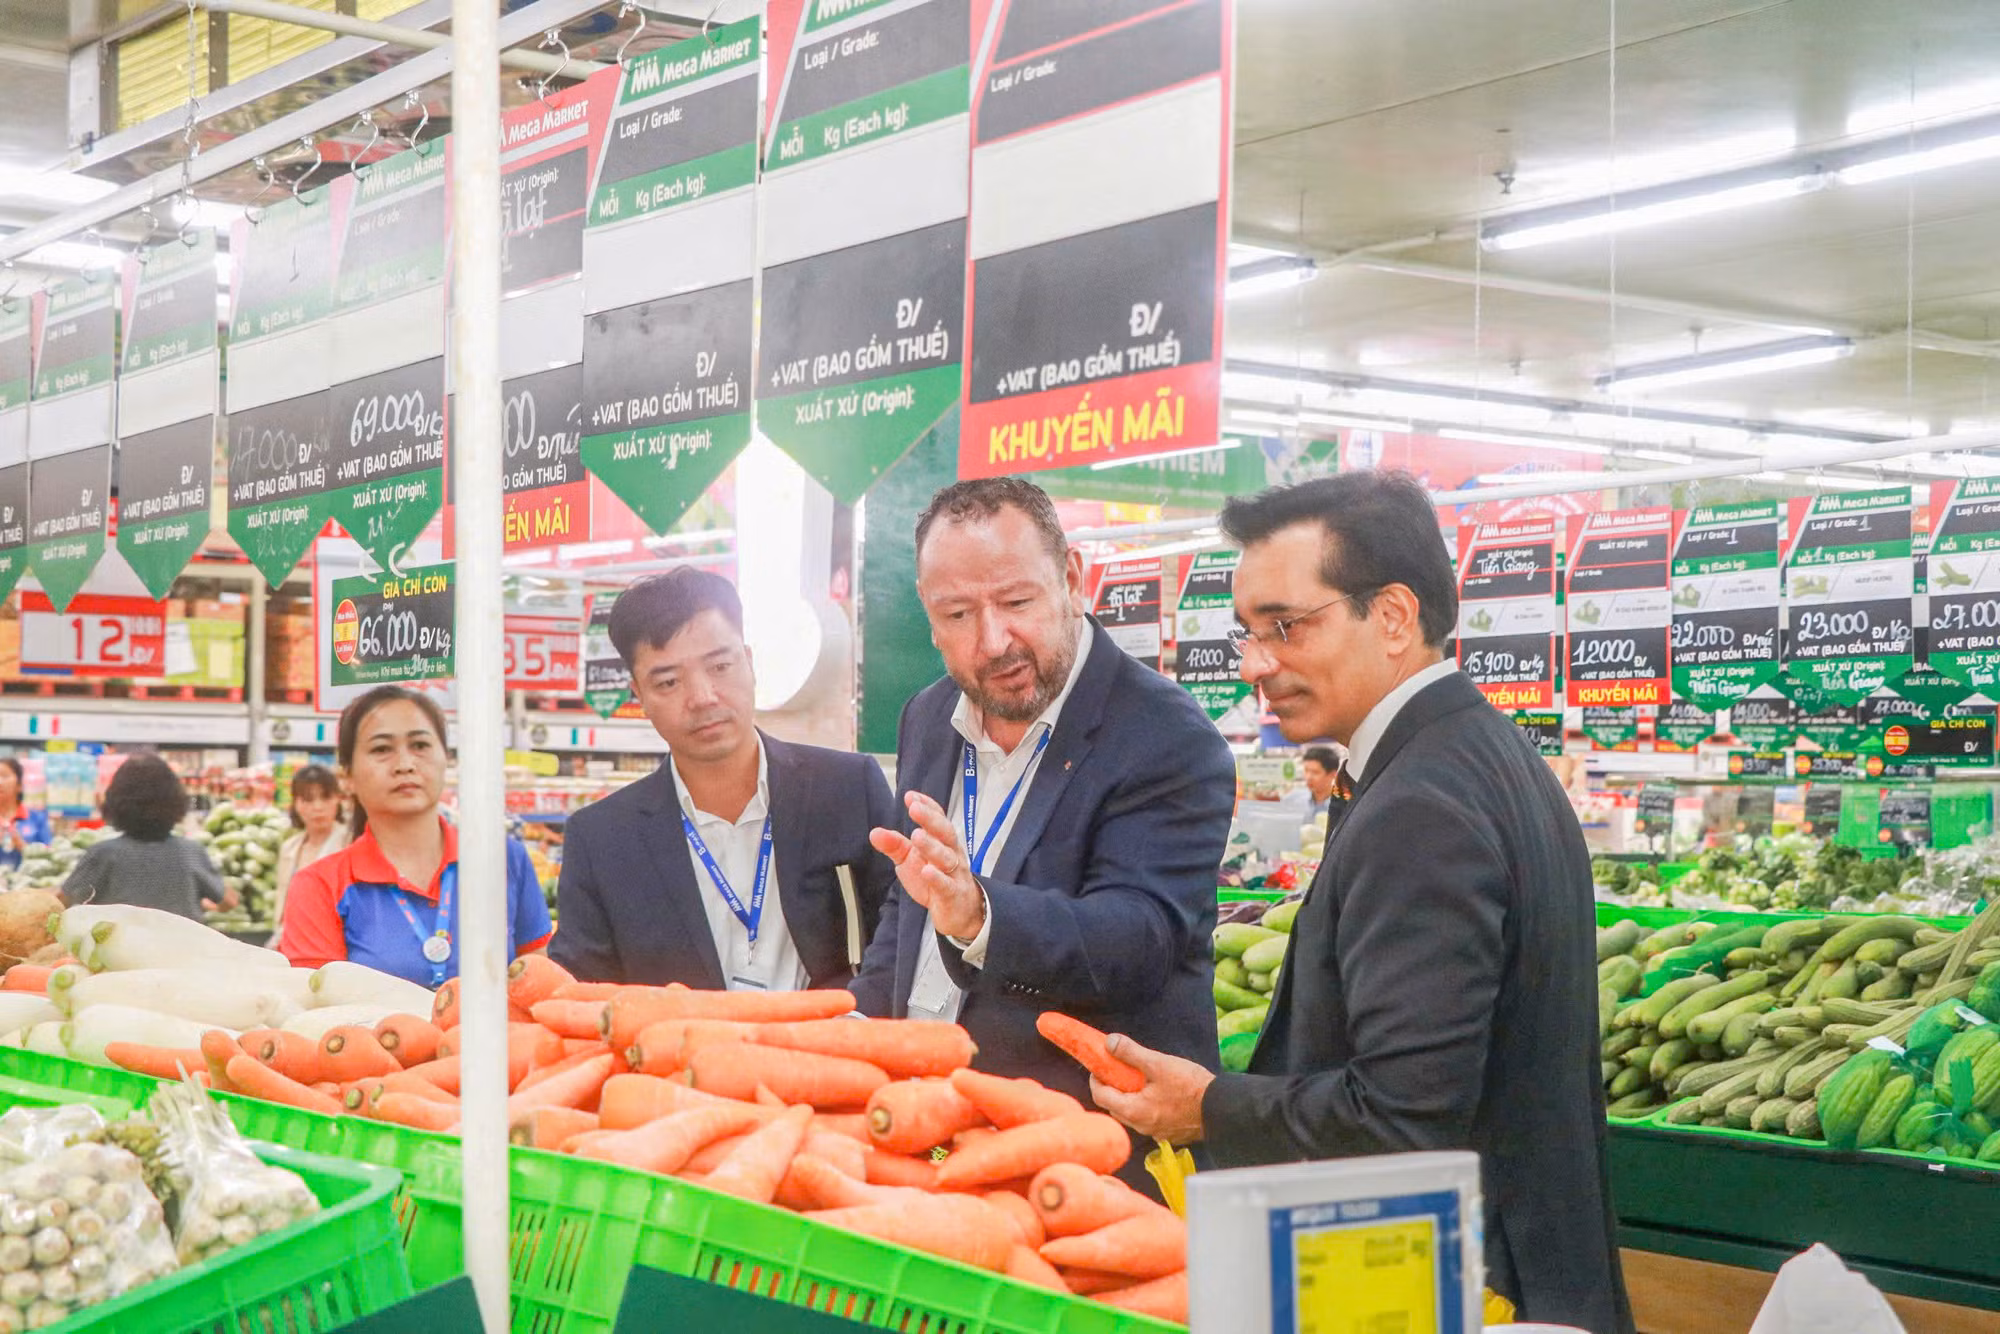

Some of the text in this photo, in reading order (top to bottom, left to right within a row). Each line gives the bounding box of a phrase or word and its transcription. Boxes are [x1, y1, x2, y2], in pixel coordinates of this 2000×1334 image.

[804, 30, 880, 70] Loại Grade:
[620, 106, 682, 139] Loại Grade:
[824, 126, 841, 149] Kg
[844, 110, 881, 144] (Each
[885, 103, 909, 131] kg):
[529, 167, 559, 192] (Origin):
[636, 191, 649, 211] Kg
[653, 176, 684, 206] (Each
[686, 173, 706, 198] kg):
[896, 297, 923, 329] Đ/
[1129, 301, 1163, 337] Đ/
[696, 352, 717, 378] Đ/
[770, 359, 808, 388] +VAT
[812, 351, 850, 385] (BAO
[896, 319, 949, 363] THUẾ)
[996, 367, 1037, 394] +VAT
[1040, 359, 1081, 391] (BAO
[1126, 330, 1181, 370] THUẾ)
[592, 402, 623, 425] +VAT
[627, 395, 659, 424] (BAO
[697, 372, 739, 409] THUẾ)
[795, 391, 834, 424] XUẤT
[862, 384, 916, 416] (Origin):
[350, 389, 425, 447] 69.000
[989, 386, 1186, 465] KHUYẾN MÃI
[337, 458, 361, 481] +VAT
[363, 453, 387, 478] (BAO
[415, 436, 444, 460] THUẾ
[613, 431, 645, 460] XUẤT
[234, 481, 254, 501] +VAT
[256, 477, 276, 500] (BAO
[300, 459, 325, 488] THUẾ)
[537, 457, 567, 483] THUẾ)
[123, 501, 141, 519] +VAT
[143, 497, 161, 518] (BAO
[353, 483, 377, 509] XUẤT
[395, 480, 427, 503] (Origin):
[535, 496, 570, 538] MÃI
[383, 577, 400, 599] GIÁ
[424, 571, 447, 594] CÒN
[1797, 610, 1869, 642] 23.000
[1932, 600, 2000, 630] 27.00
[359, 610, 417, 657] 66.000
[1671, 620, 1735, 648] 22.000
[1938, 635, 1994, 650] +VAT (BAO
[1674, 652, 1697, 663] +VAT
[1698, 651, 1720, 663] (BAO
[1796, 645, 1820, 657] +VAT
[1822, 644, 1846, 657] (BAO
[1517, 687, 1541, 704] MÃI
[1579, 681, 1658, 703] KHUYẾN MÃI
